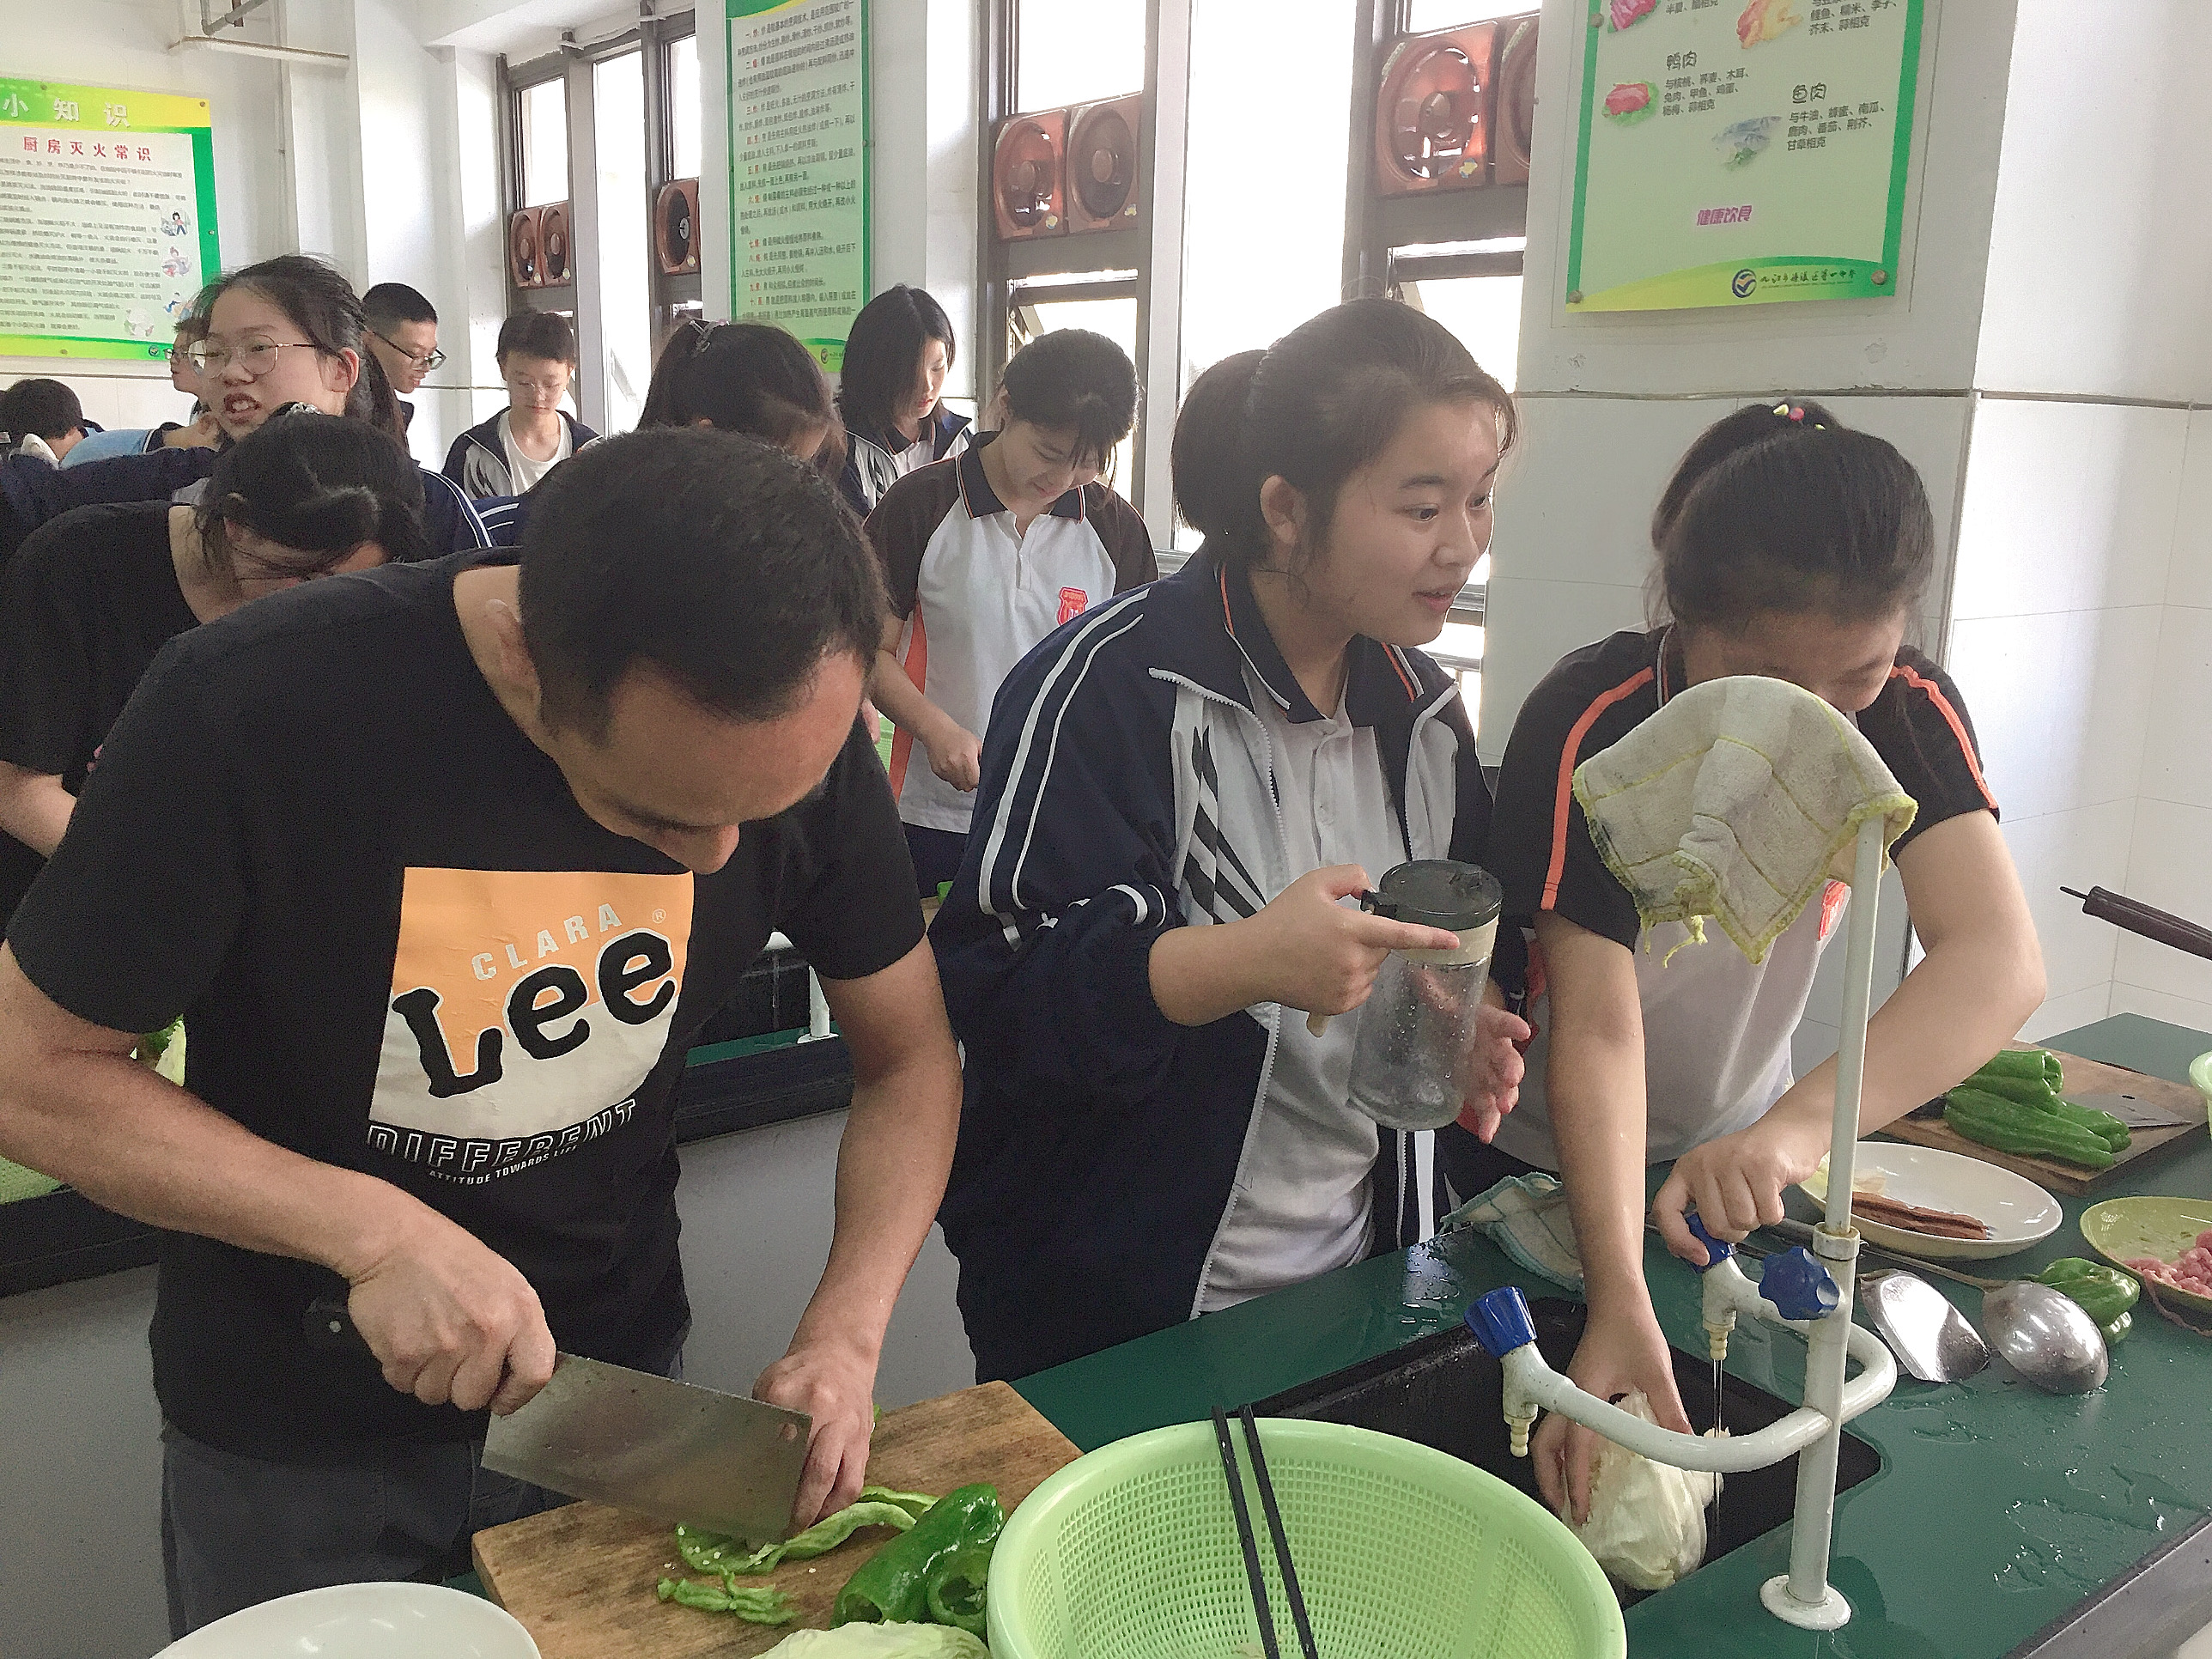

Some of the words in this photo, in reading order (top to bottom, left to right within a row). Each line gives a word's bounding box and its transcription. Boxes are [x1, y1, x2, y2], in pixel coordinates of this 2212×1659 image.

[1666, 51, 1698, 70] 鸭肉
[1792, 82, 1826, 103] 鱼肉
[3, 94, 131, 128] 小知识
[23, 136, 151, 161] 厨房灭火常识
[1697, 205, 1753, 226] 健康饮食
[471, 902, 623, 981] CLARA
[391, 927, 679, 1099] Lee
[367, 1099, 636, 1173] DIFFERENT
[429, 1169, 491, 1185] ATTITUDE
[495, 1152, 550, 1178] TOWARDS
